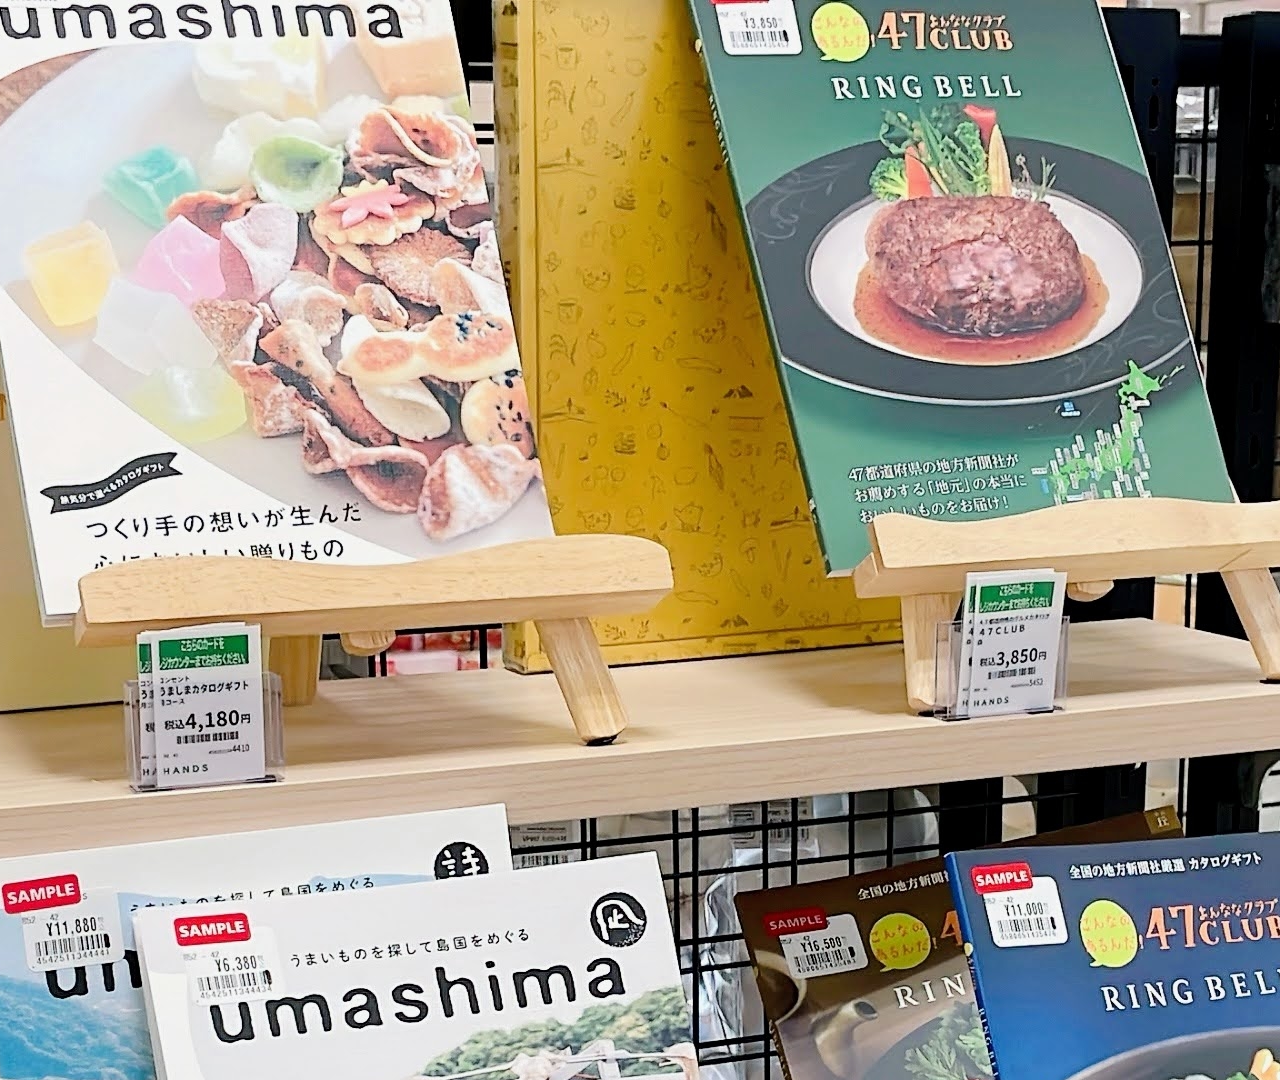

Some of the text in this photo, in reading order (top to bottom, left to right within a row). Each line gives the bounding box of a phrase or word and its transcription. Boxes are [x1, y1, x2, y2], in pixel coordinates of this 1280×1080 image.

[878, 11, 926, 50] 47
[929, 28, 1014, 50] CLUB
[831, 75, 1022, 100] RING BELL
[848, 453, 1020, 482] 47都道府県の地方新聞社が
[86, 502, 363, 538] つくり手の想いが生んだ
[980, 625, 1026, 636] 47CLUB
[974, 696, 1009, 706] HANDS
[163, 764, 209, 775] HANDS
[1069, 851, 1263, 881] 全国の地方新聞社厳選 カタログギフト
[974, 870, 1030, 891] SAMPLE
[6, 882, 76, 905] SAMPLE
[178, 919, 246, 939] SAMPLE
[769, 914, 823, 931] SAMPLE
[1145, 904, 1195, 951] 47
[289, 927, 530, 968] うまいものを探して島国をめぐる
[210, 956, 626, 1044] umashima
[1101, 977, 1194, 1012] RING
